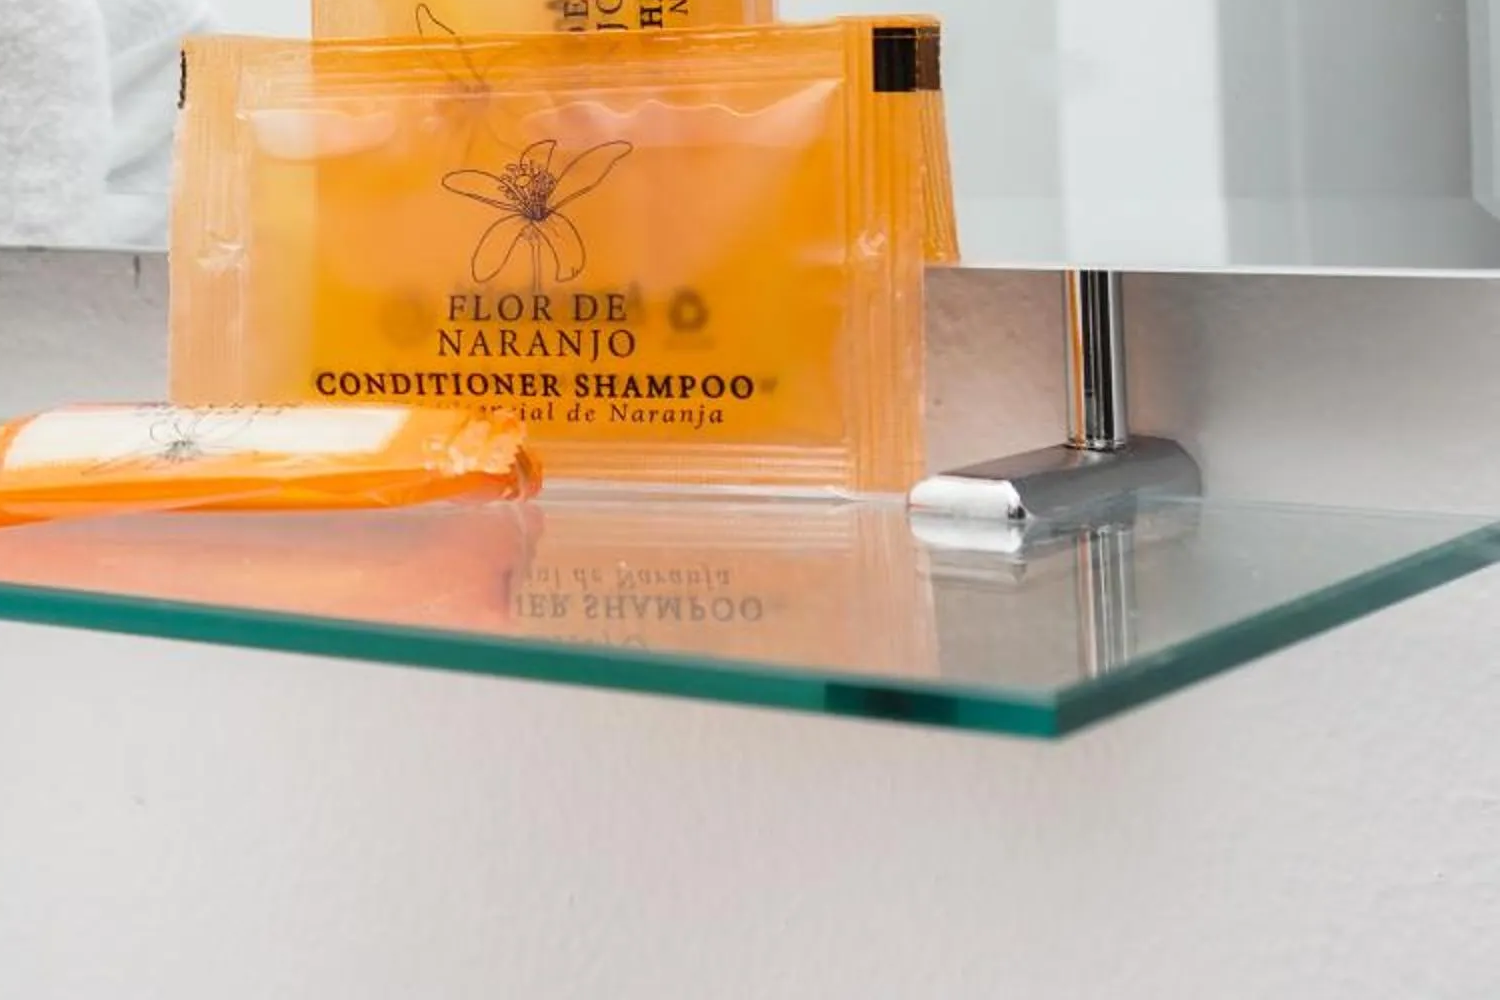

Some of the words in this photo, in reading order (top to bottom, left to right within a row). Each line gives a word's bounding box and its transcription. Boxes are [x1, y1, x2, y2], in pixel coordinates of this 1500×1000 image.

[448, 294, 553, 323] FLOR
[573, 293, 628, 323] DE
[437, 328, 637, 363] NARANJO
[315, 371, 563, 398] CONDITIONER
[574, 373, 756, 400] SHAMPOO
[566, 402, 597, 422] de
[611, 402, 725, 430] Naranja
